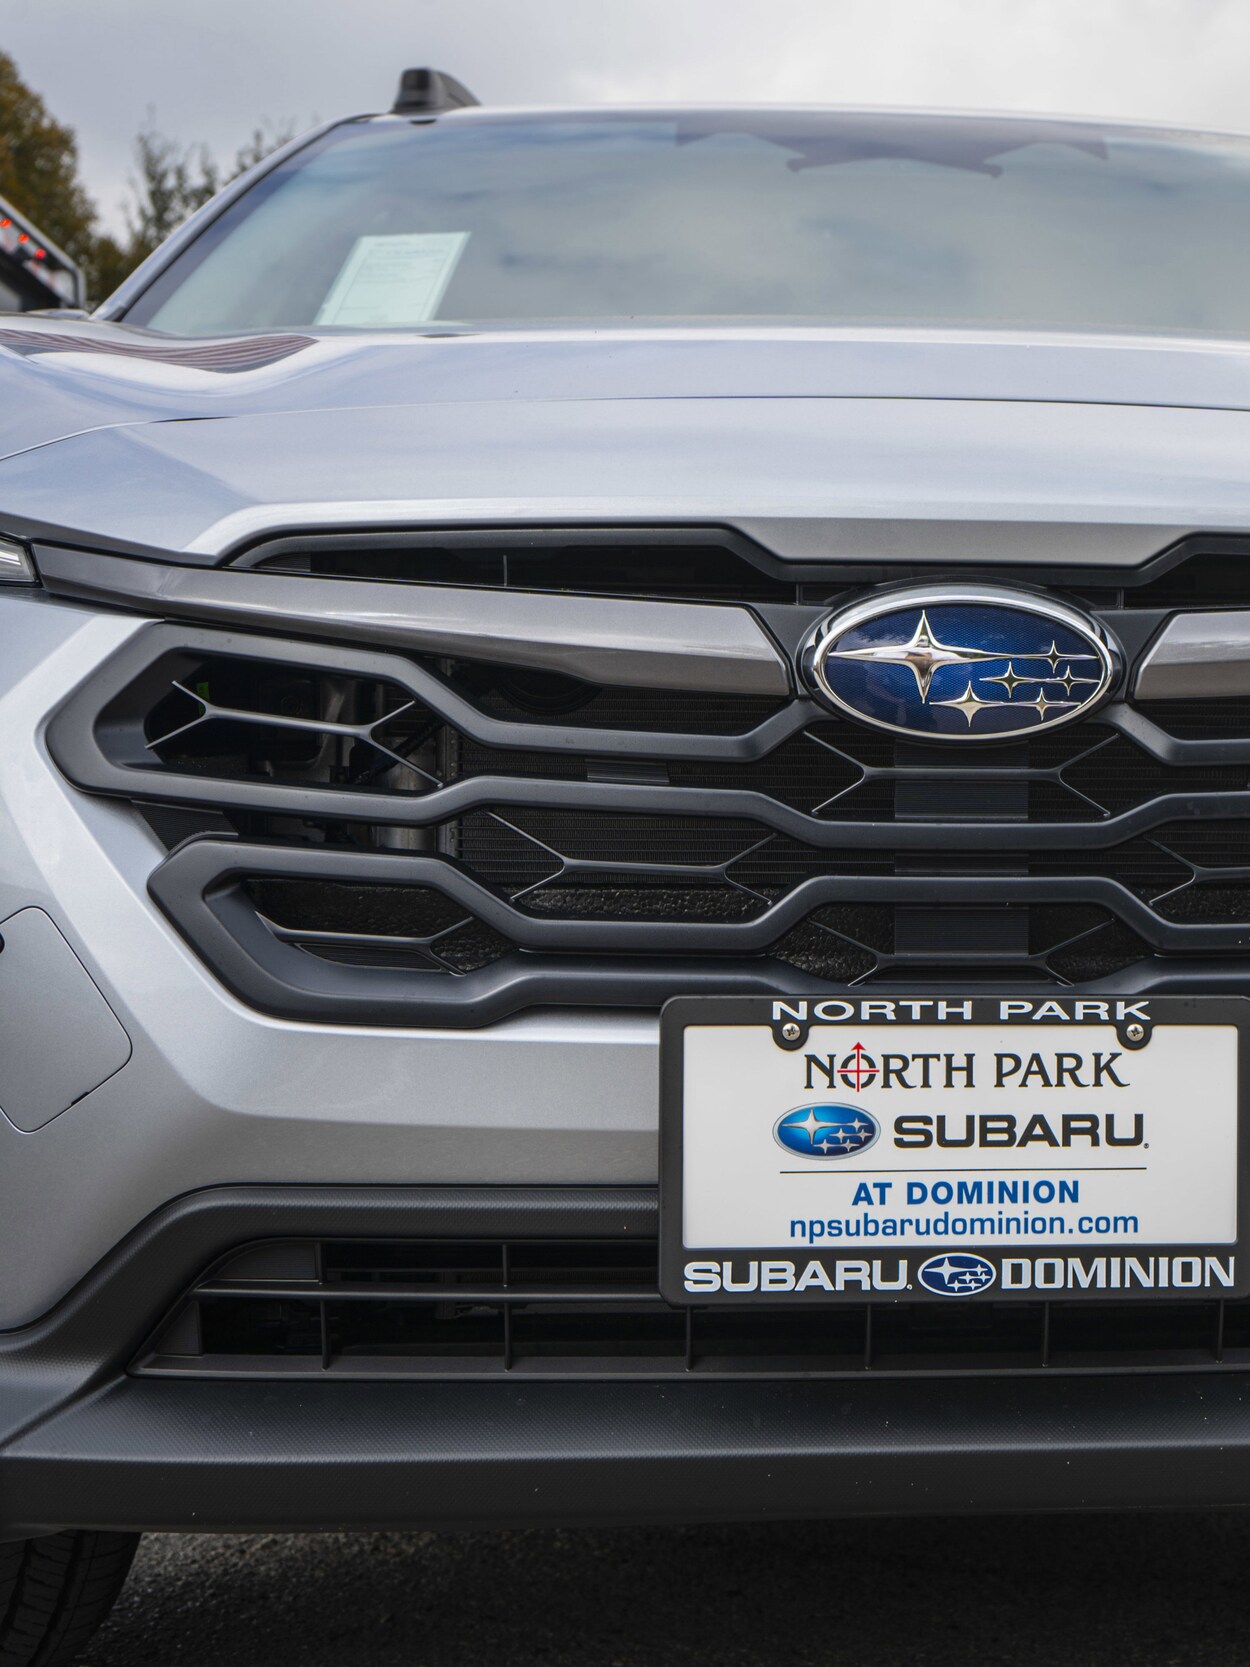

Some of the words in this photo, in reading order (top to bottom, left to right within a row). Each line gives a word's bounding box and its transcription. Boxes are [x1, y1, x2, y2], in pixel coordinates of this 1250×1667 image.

[772, 1000, 972, 1020] NORTH
[1000, 1000, 1151, 1020] PARK
[804, 1053, 975, 1089] NORTH
[994, 1052, 1130, 1088] PARK
[893, 1113, 1144, 1148] SUBARU
[852, 1182, 892, 1206] AT
[906, 1180, 1079, 1205] DOMINION
[790, 1212, 1139, 1244] npsubarudominion.com
[683, 1259, 908, 1293] SUBARU
[1001, 1256, 1235, 1289] DOMINION
